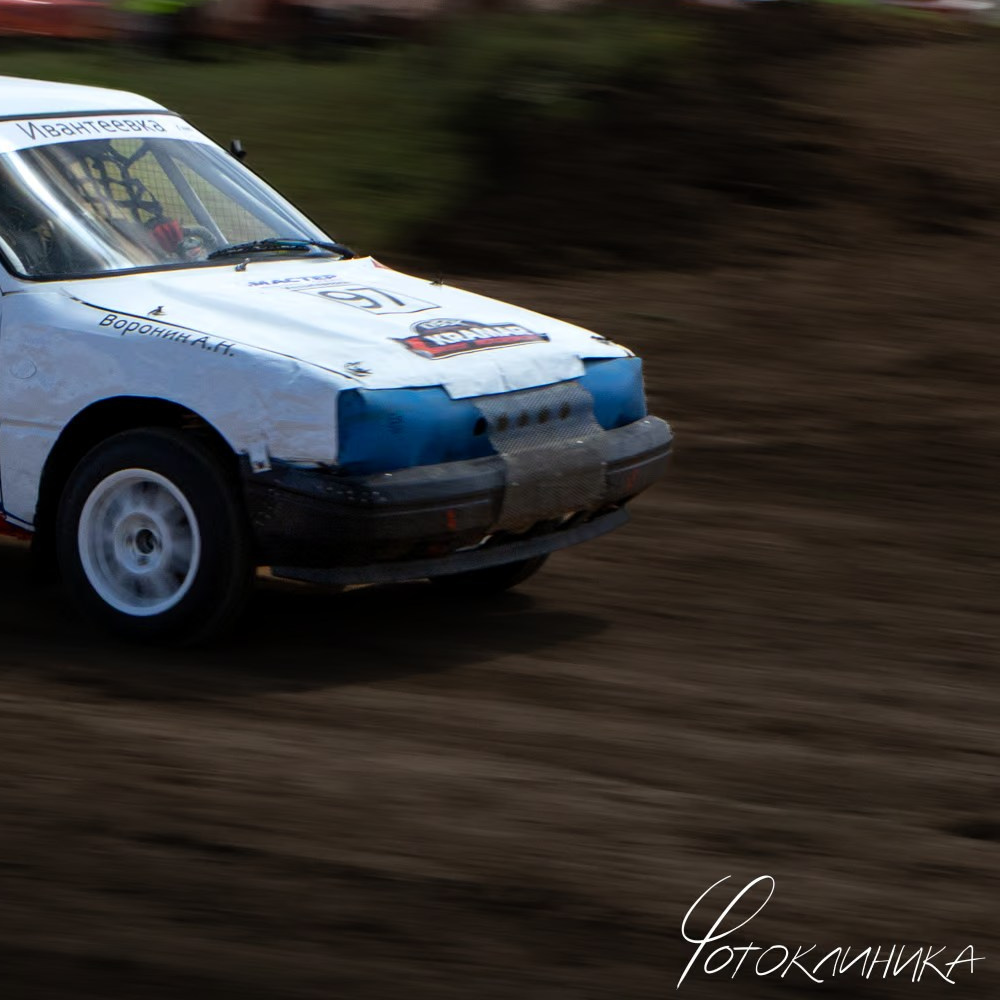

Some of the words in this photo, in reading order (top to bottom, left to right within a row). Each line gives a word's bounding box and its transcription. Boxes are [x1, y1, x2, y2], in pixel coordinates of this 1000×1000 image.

[16, 118, 166, 142] Ивантеевка
[318, 286, 406, 310] 97
[98, 313, 191, 344] Воронин
[190, 335, 236, 357] А.Н.
